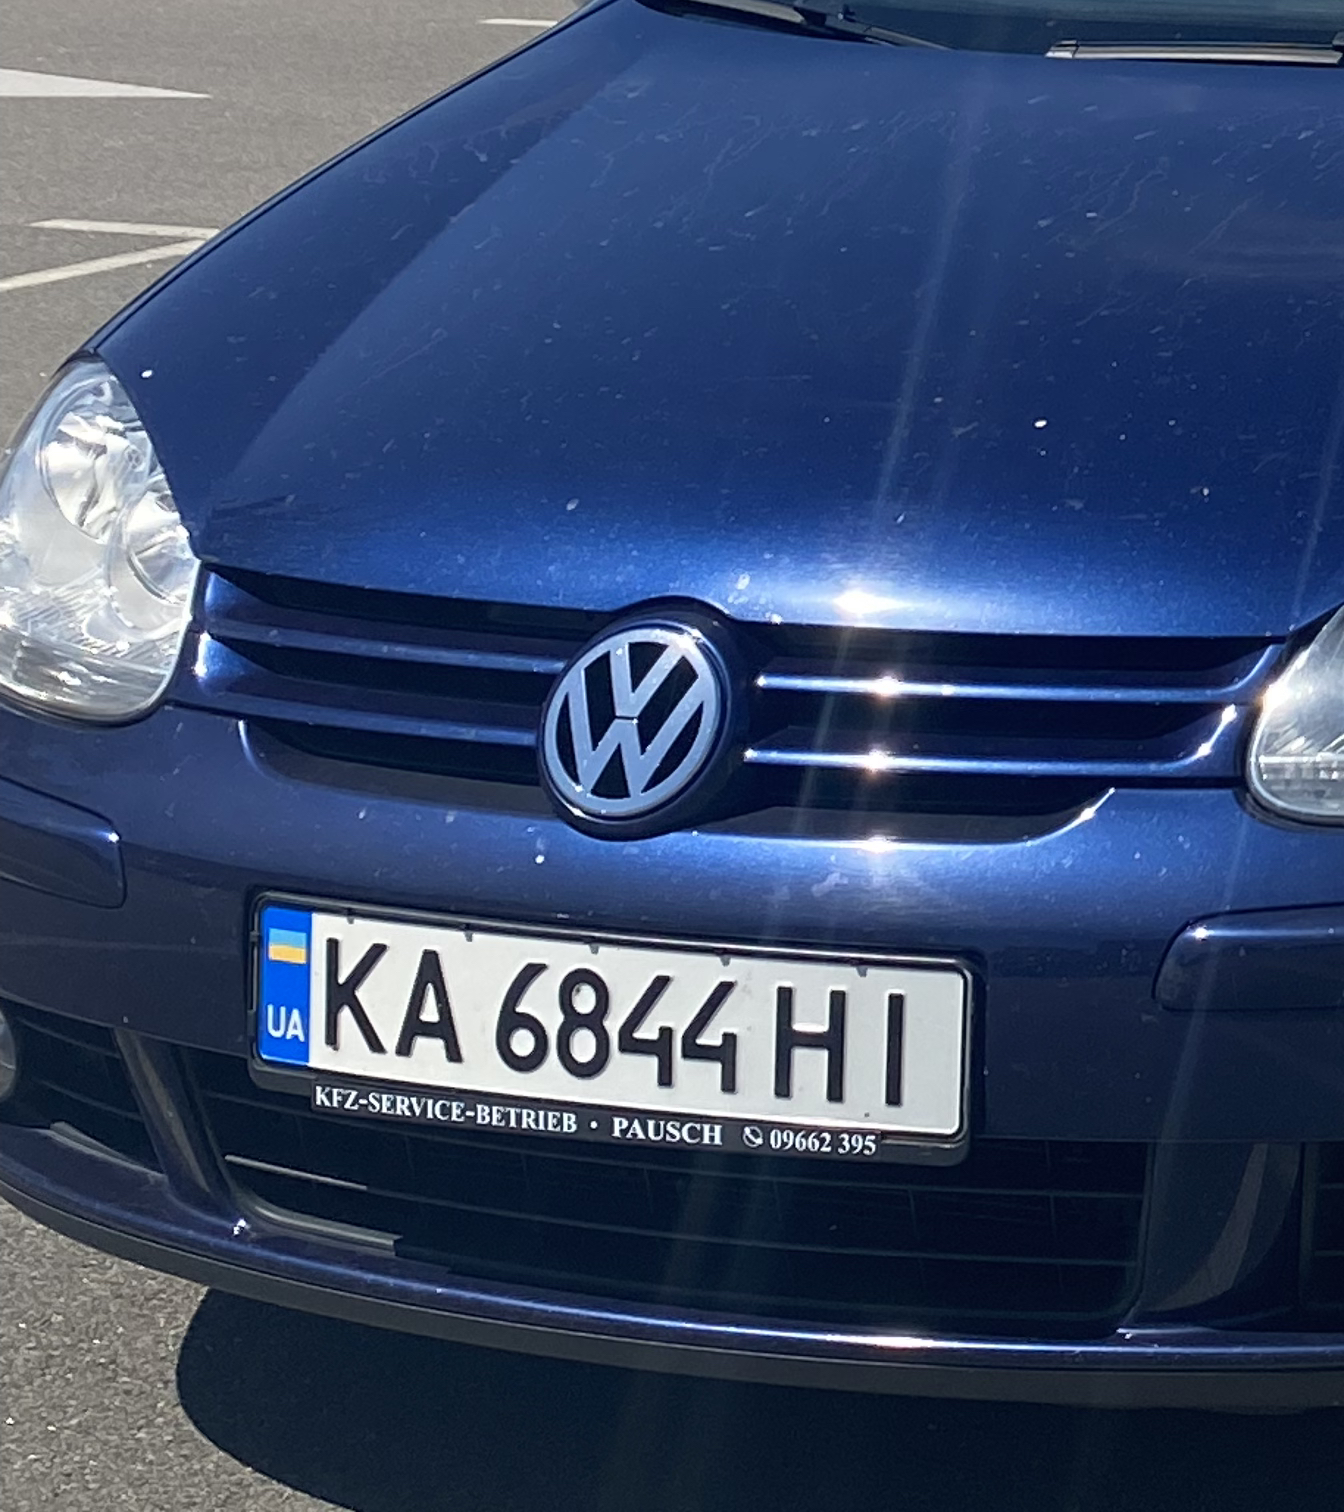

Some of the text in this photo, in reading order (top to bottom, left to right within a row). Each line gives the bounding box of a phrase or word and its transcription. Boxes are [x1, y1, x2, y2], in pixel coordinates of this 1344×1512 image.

[267, 1005, 306, 1042] UA
[324, 938, 905, 1107] KA 6844 HI
[315, 1085, 877, 1155] KFZ-SERVICE-BETRIEB PAUSCH 09662 395
